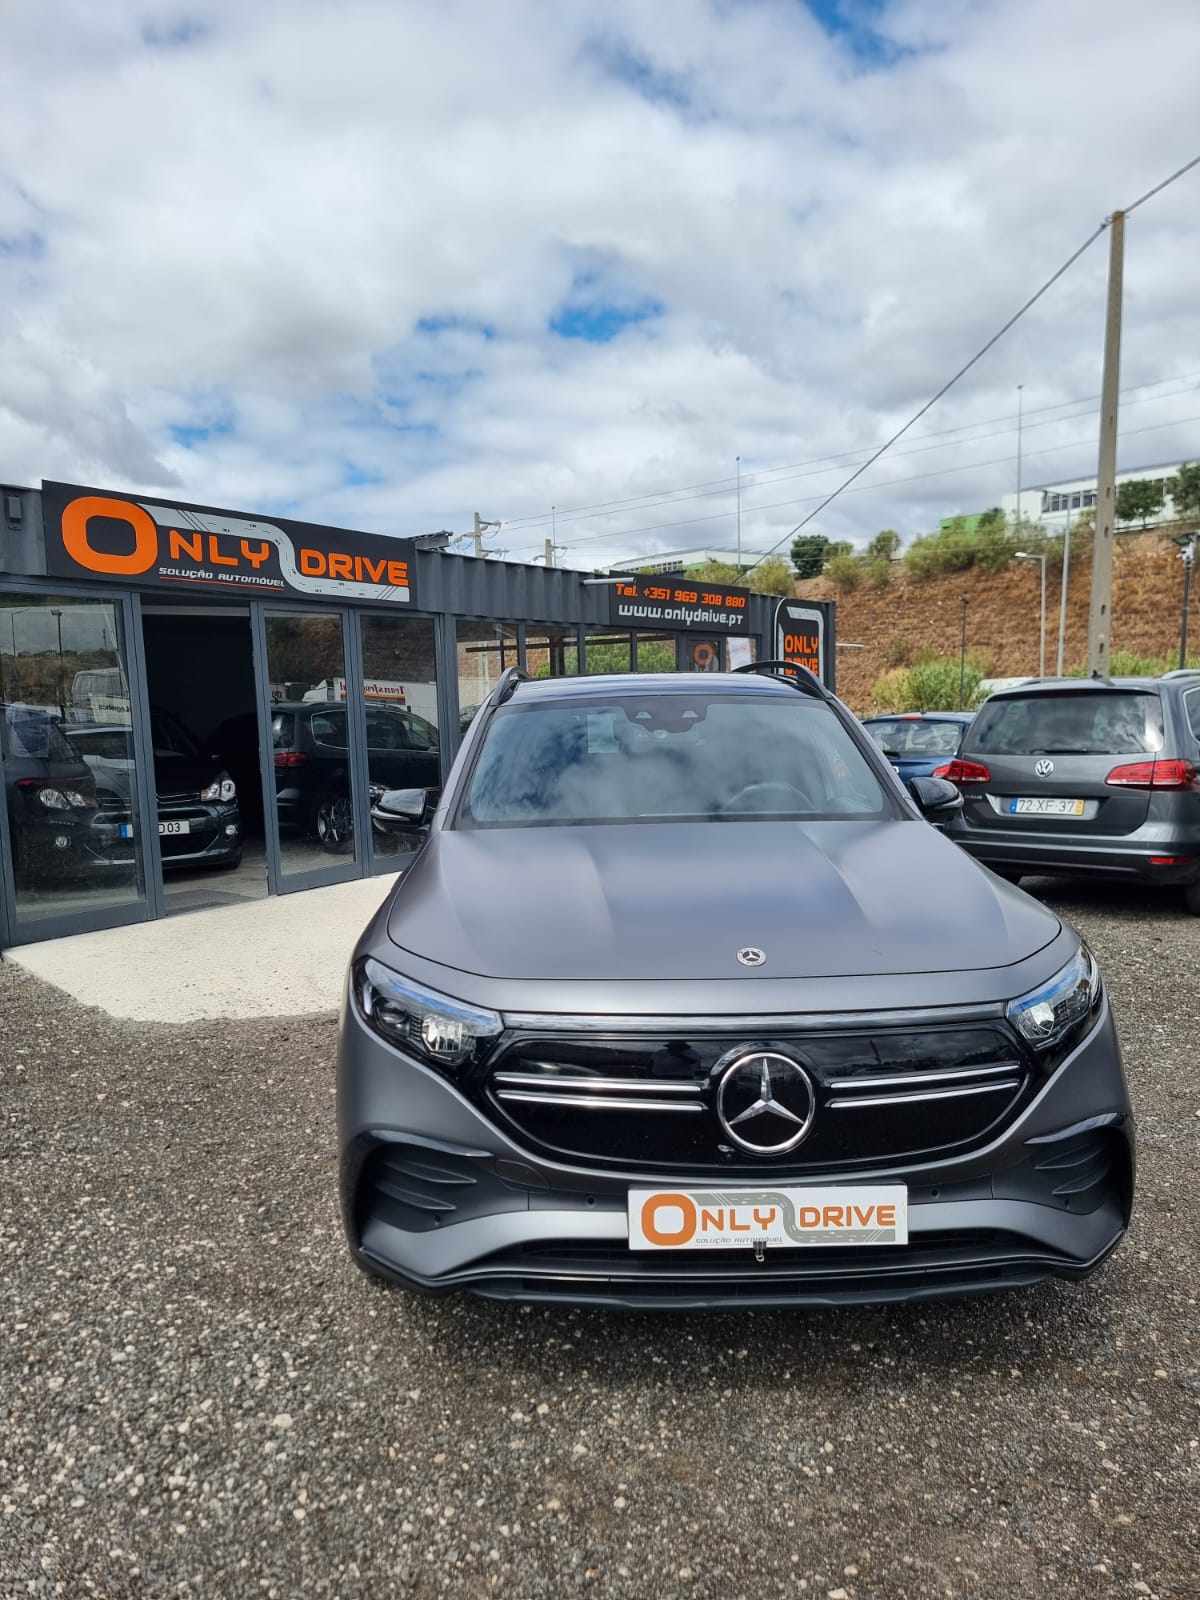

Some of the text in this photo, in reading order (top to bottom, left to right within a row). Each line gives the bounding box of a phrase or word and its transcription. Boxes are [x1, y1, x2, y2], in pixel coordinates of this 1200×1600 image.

[61, 496, 410, 587] ONLY DRIVE
[615, 582, 745, 608] Tel. +351 969 308 880
[784, 634, 819, 655] ONLY
[641, 1193, 896, 1247] ONLY DRIVE
